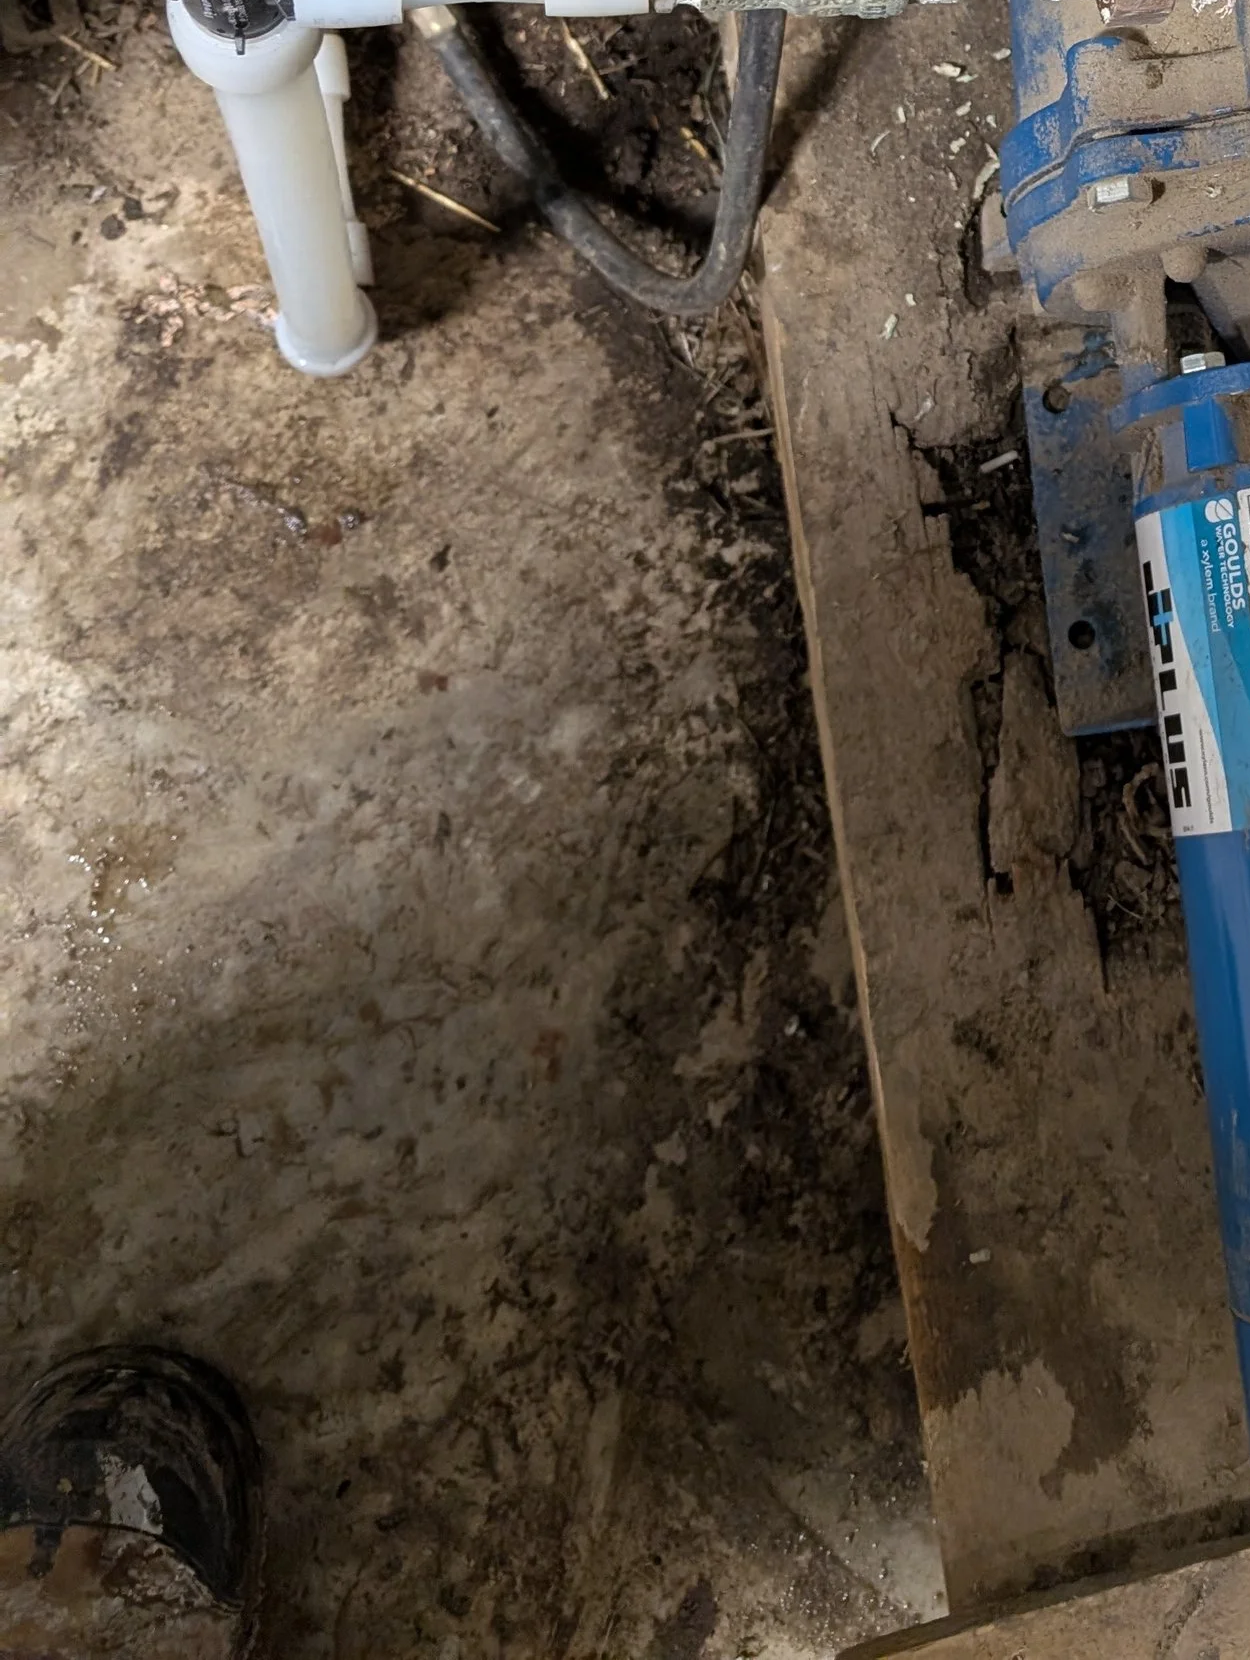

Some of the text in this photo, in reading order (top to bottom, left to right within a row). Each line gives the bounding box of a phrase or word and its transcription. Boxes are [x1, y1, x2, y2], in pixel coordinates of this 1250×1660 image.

[1200, 539, 1222, 633] a xylem brand
[1215, 525, 1235, 629] WATER TECHNOLOGY
[1224, 523, 1246, 611] GOULDS
